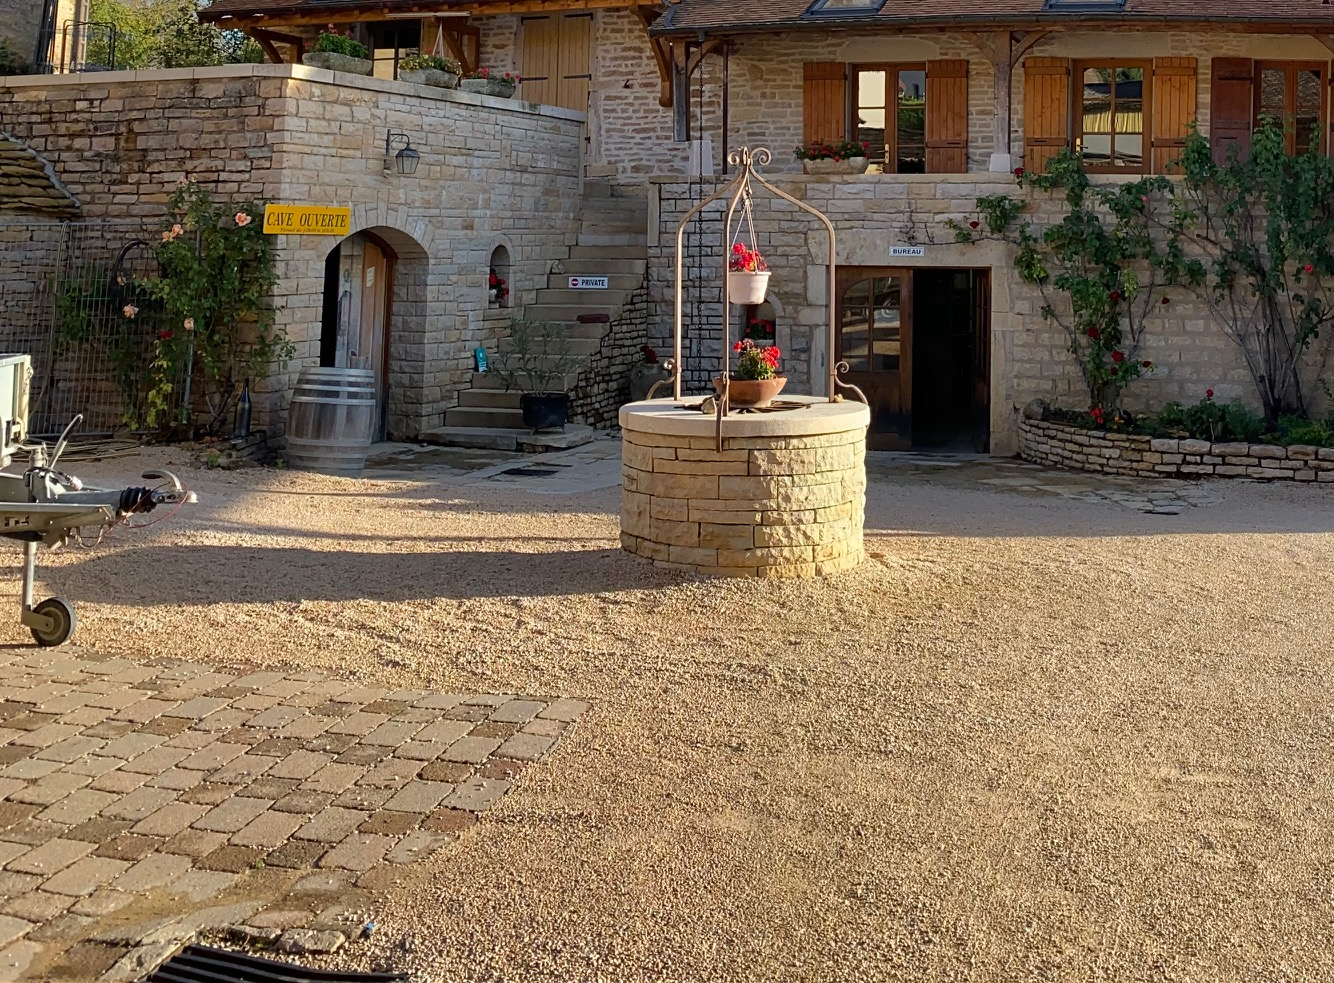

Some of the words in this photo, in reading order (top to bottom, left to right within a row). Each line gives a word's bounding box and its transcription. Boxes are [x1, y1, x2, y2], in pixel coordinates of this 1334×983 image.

[267, 212, 294, 226] CAVE
[300, 213, 347, 227] OUVERTE
[581, 278, 606, 287] PRIVATE
